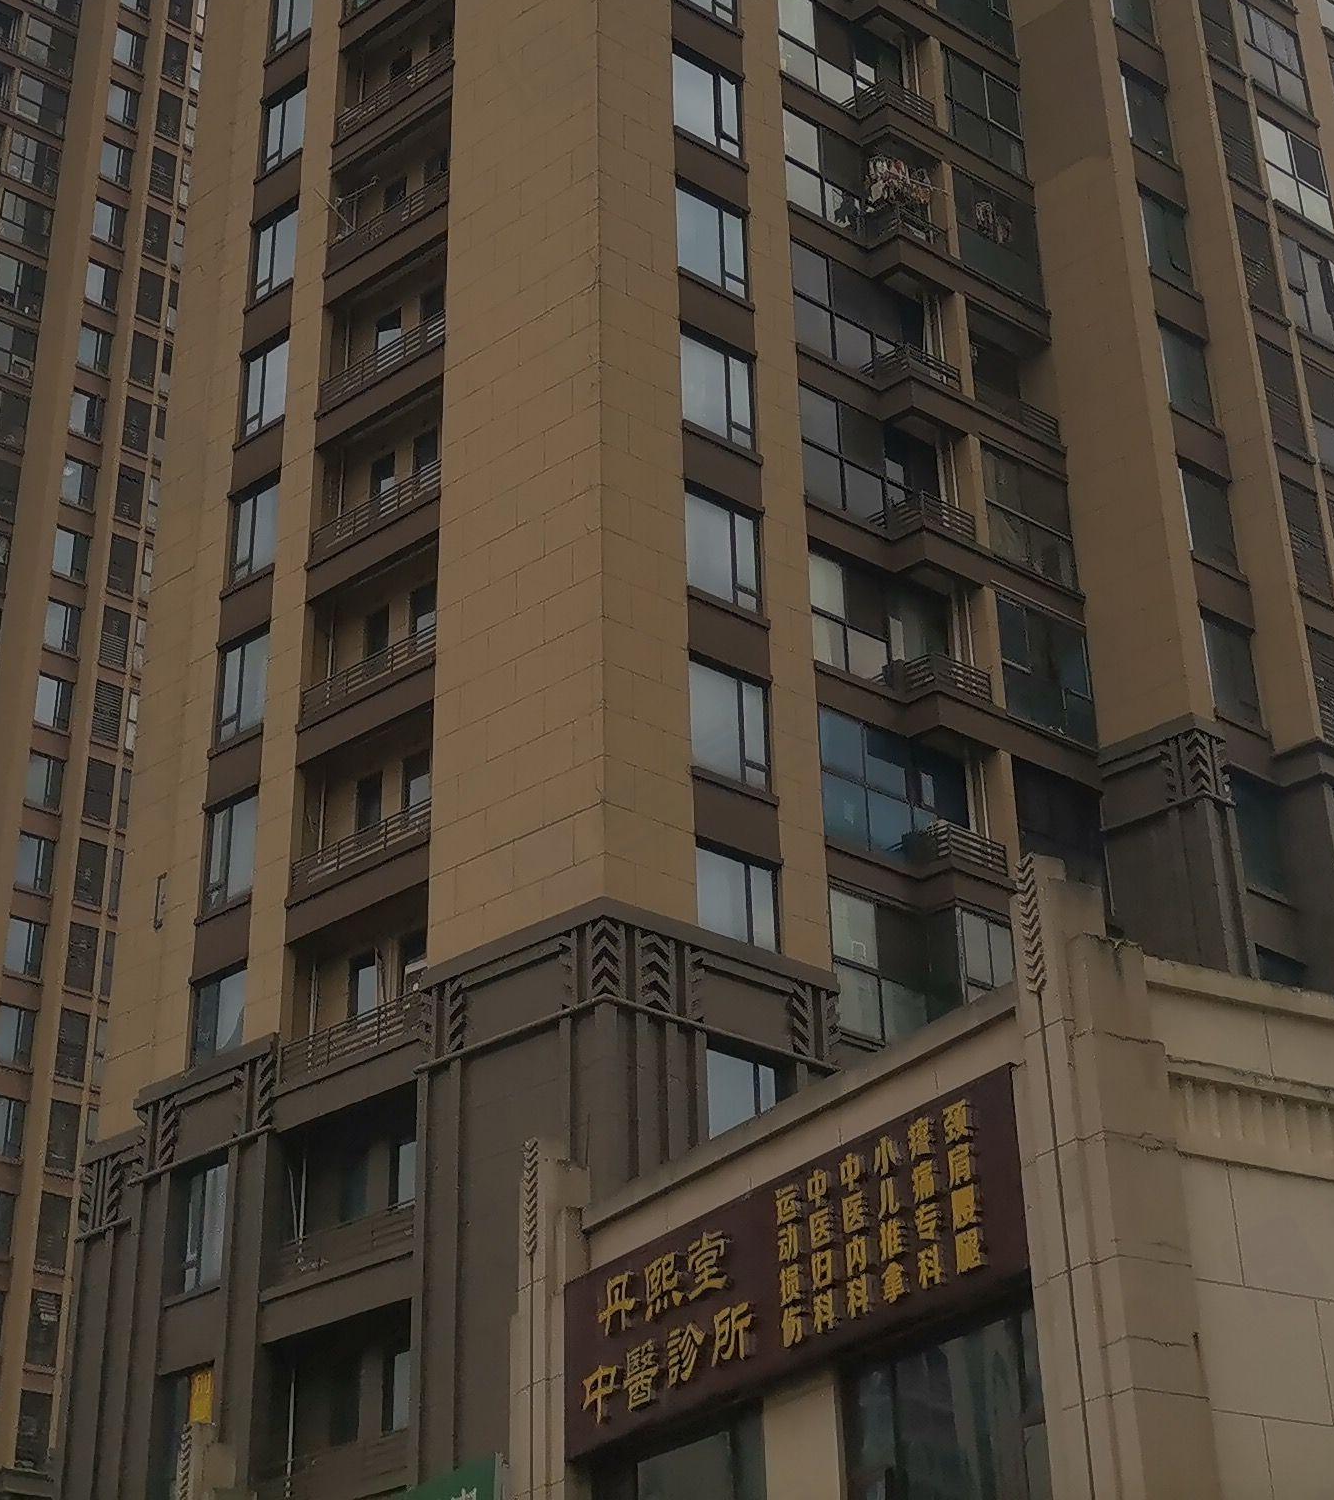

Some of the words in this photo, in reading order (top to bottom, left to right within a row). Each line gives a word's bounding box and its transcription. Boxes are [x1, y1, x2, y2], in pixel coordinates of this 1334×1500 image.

[598, 1231, 728, 1337] 丹熙堂
[774, 1182, 804, 1348] 运动损伤
[806, 1169, 835, 1334] 中医妇科
[839, 1152, 870, 1320] 中医内科
[582, 1301, 753, 1425] 中醫診所
